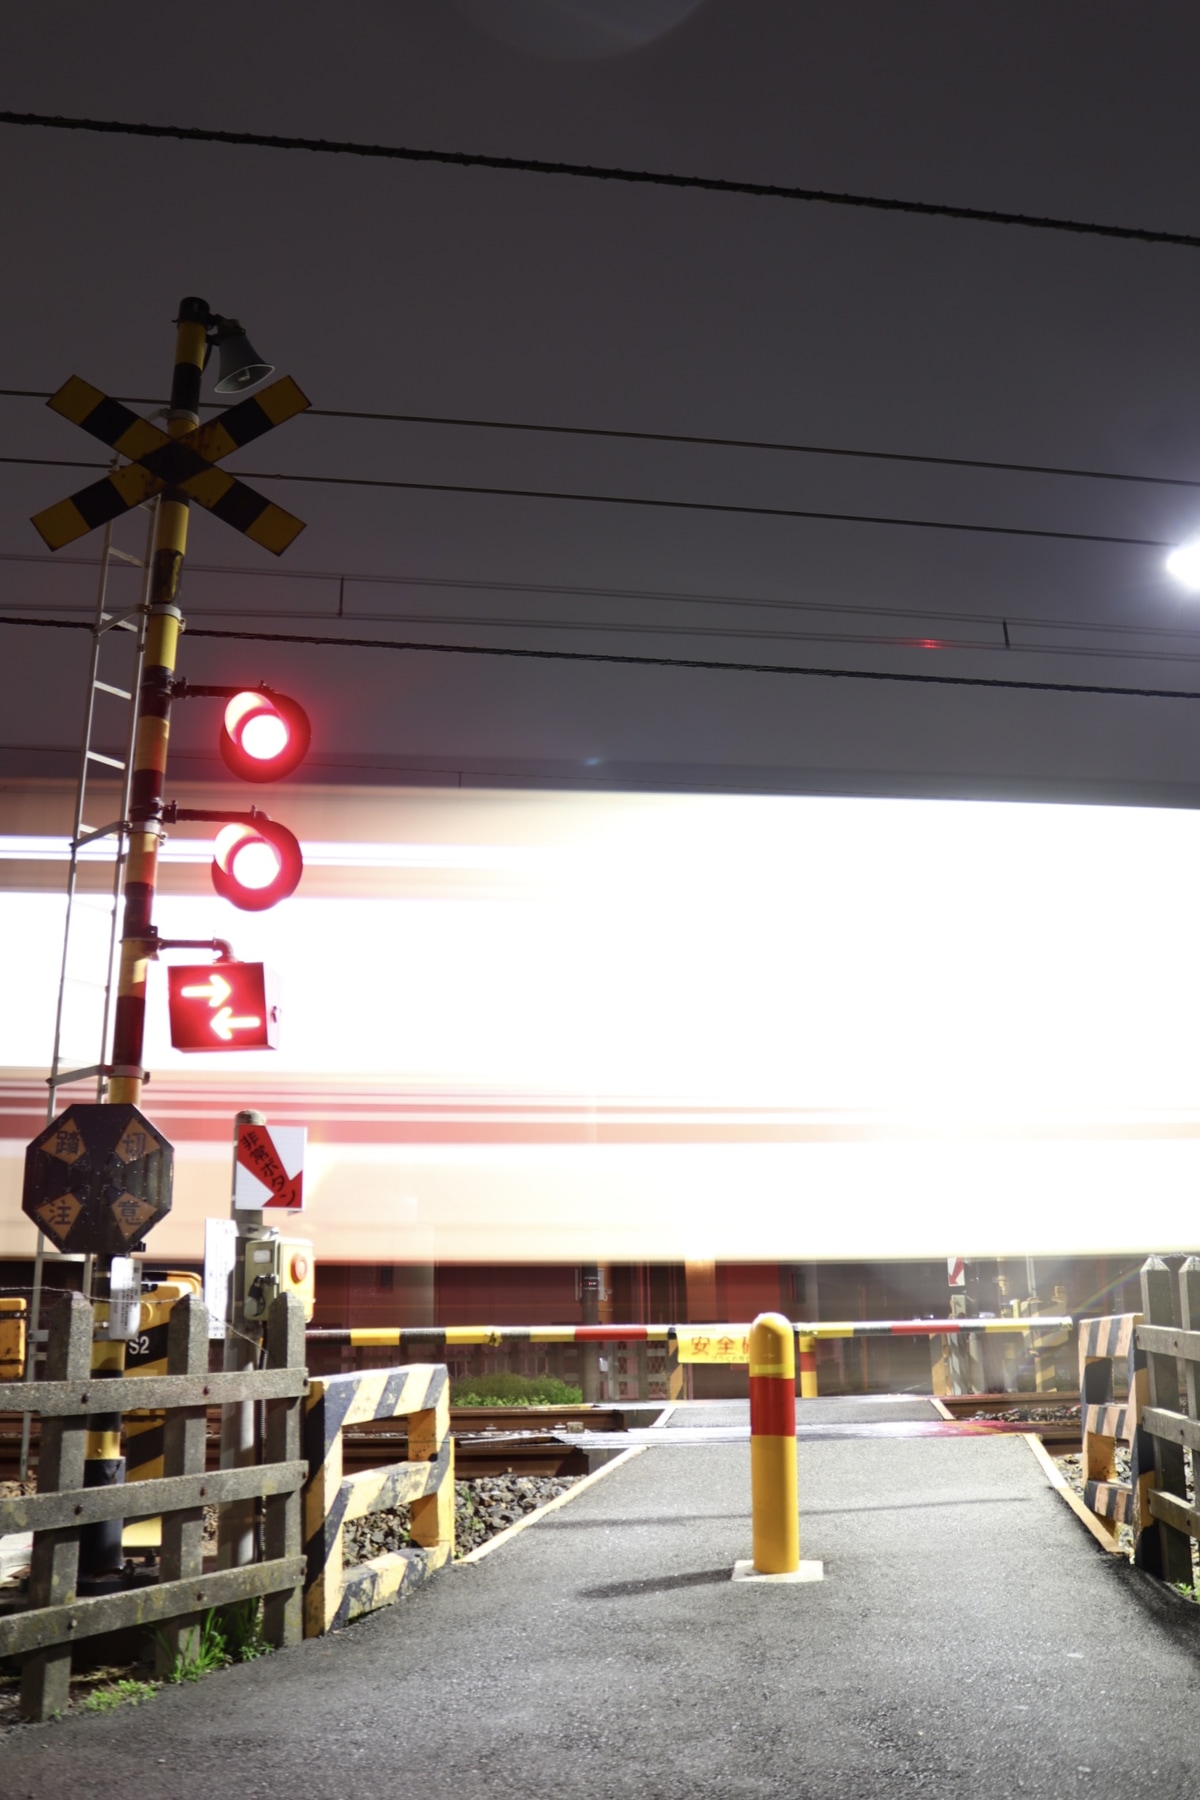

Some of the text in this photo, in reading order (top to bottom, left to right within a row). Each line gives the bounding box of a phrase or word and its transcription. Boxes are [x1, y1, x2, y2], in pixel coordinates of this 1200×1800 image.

[56, 1130, 147, 1155] 踏切
[240, 1131, 296, 1207] 非常ボタン
[45, 1199, 142, 1226] 注意
[128, 1336, 150, 1355] S2
